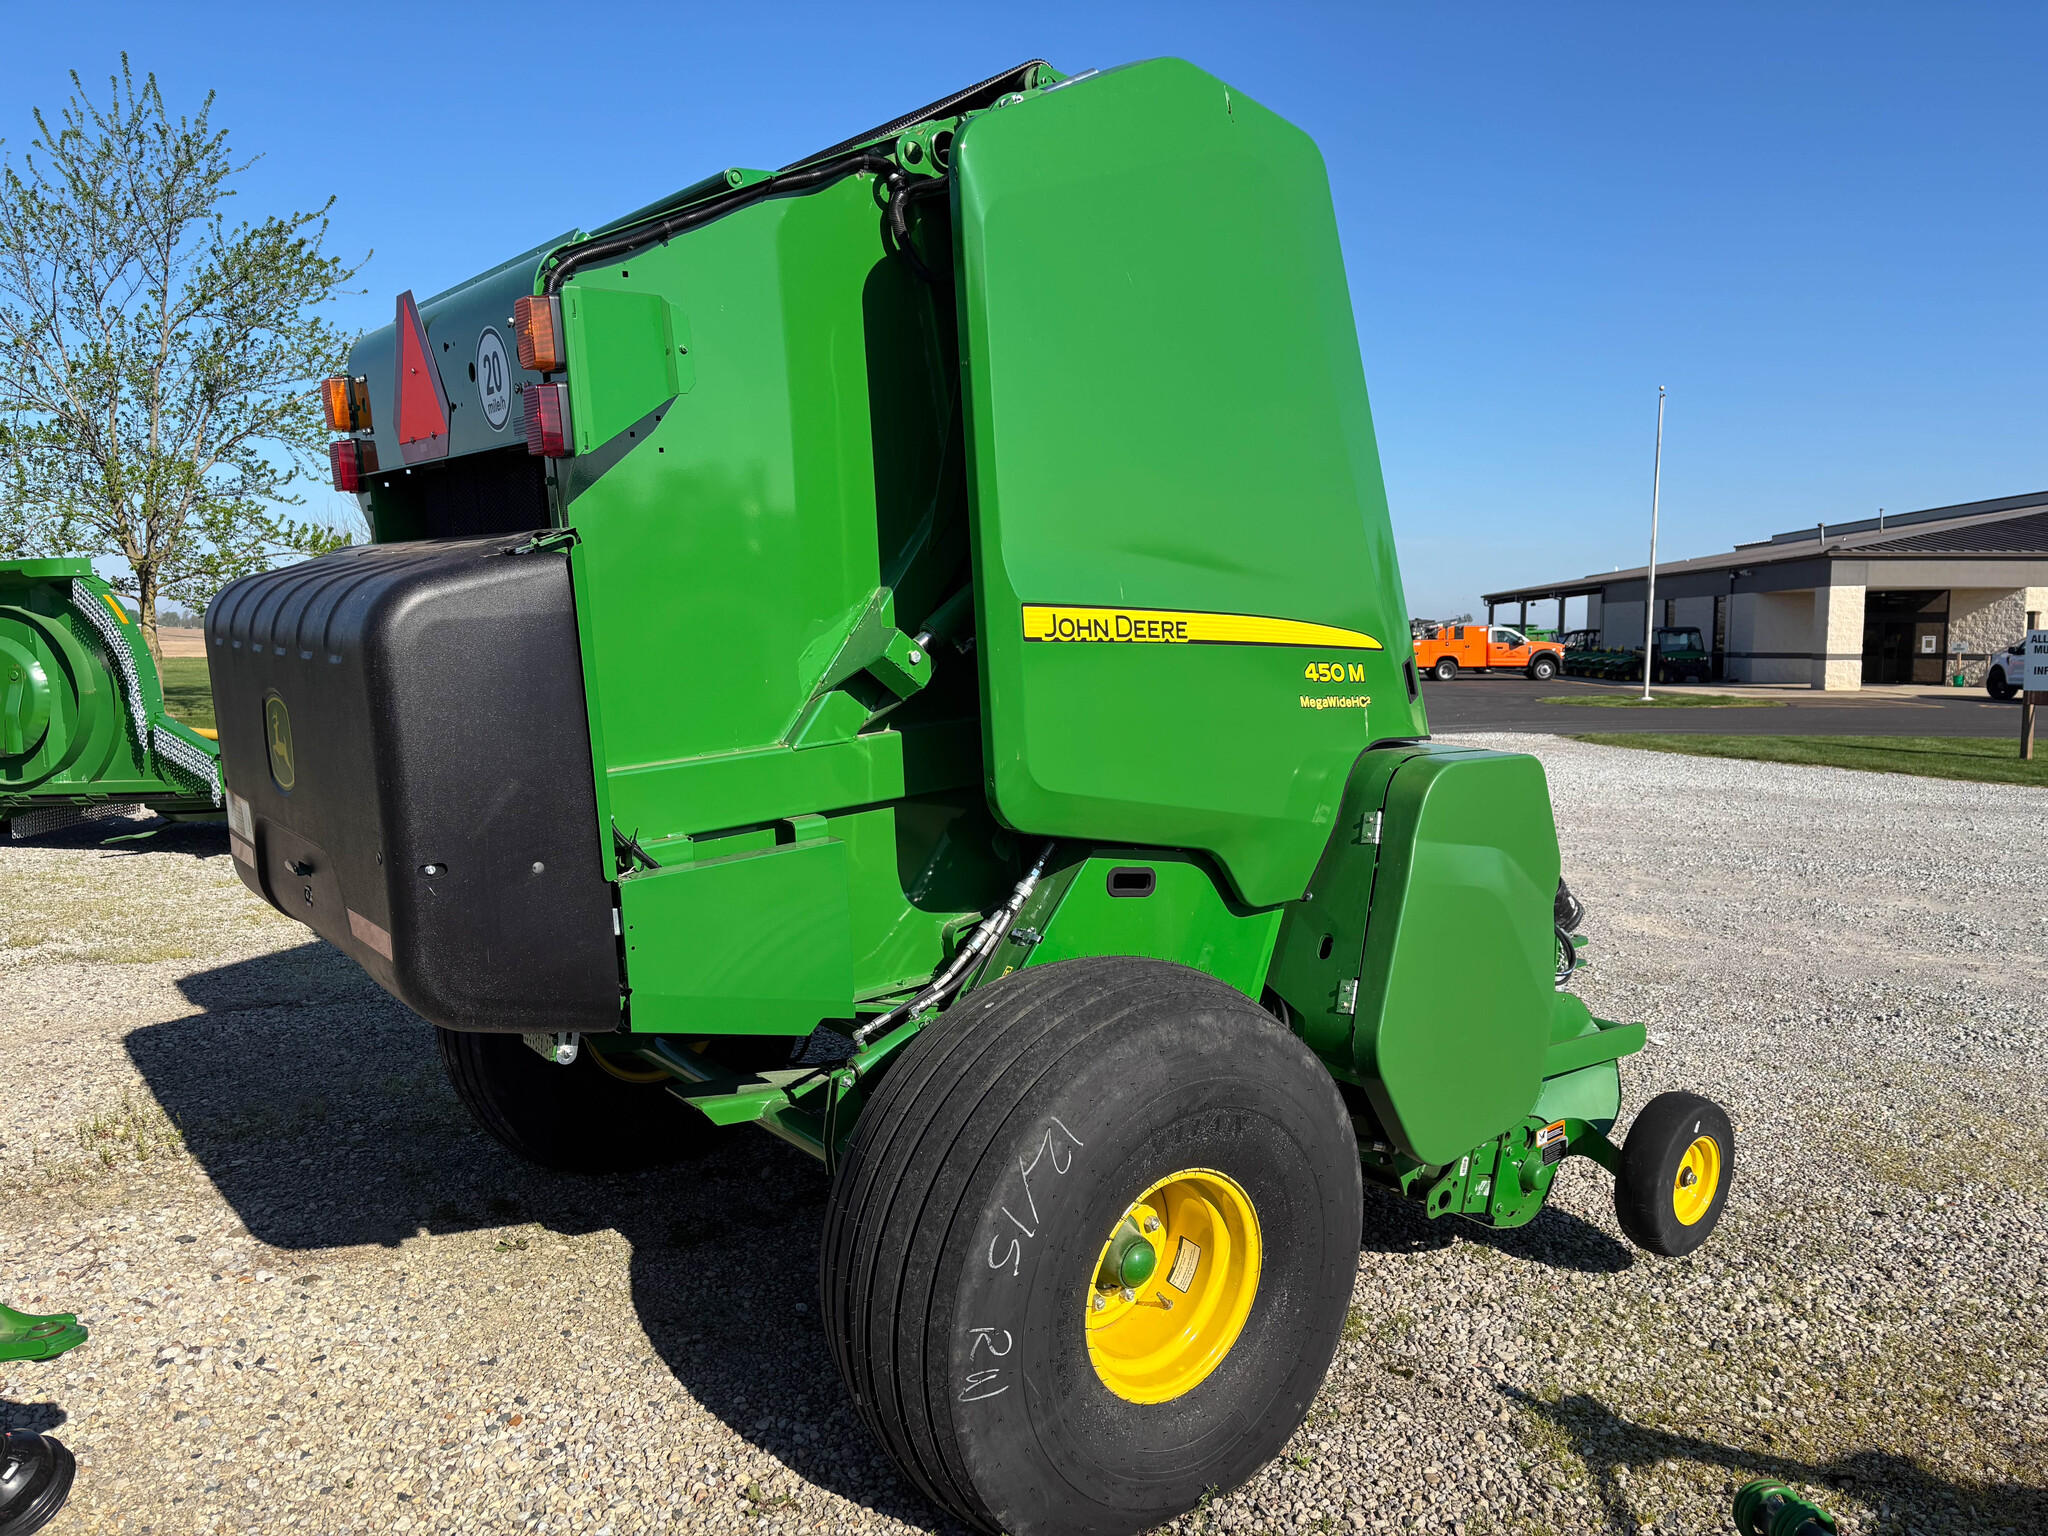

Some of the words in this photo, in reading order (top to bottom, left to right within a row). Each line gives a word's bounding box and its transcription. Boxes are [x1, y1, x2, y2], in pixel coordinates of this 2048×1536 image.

[484, 351, 502, 396] 20
[1044, 613, 1110, 638] JOHN
[1115, 615, 1188, 639] DEERE
[2031, 634, 2048, 643] ALL
[1304, 662, 1345, 683] 450
[1347, 662, 1366, 683] M
